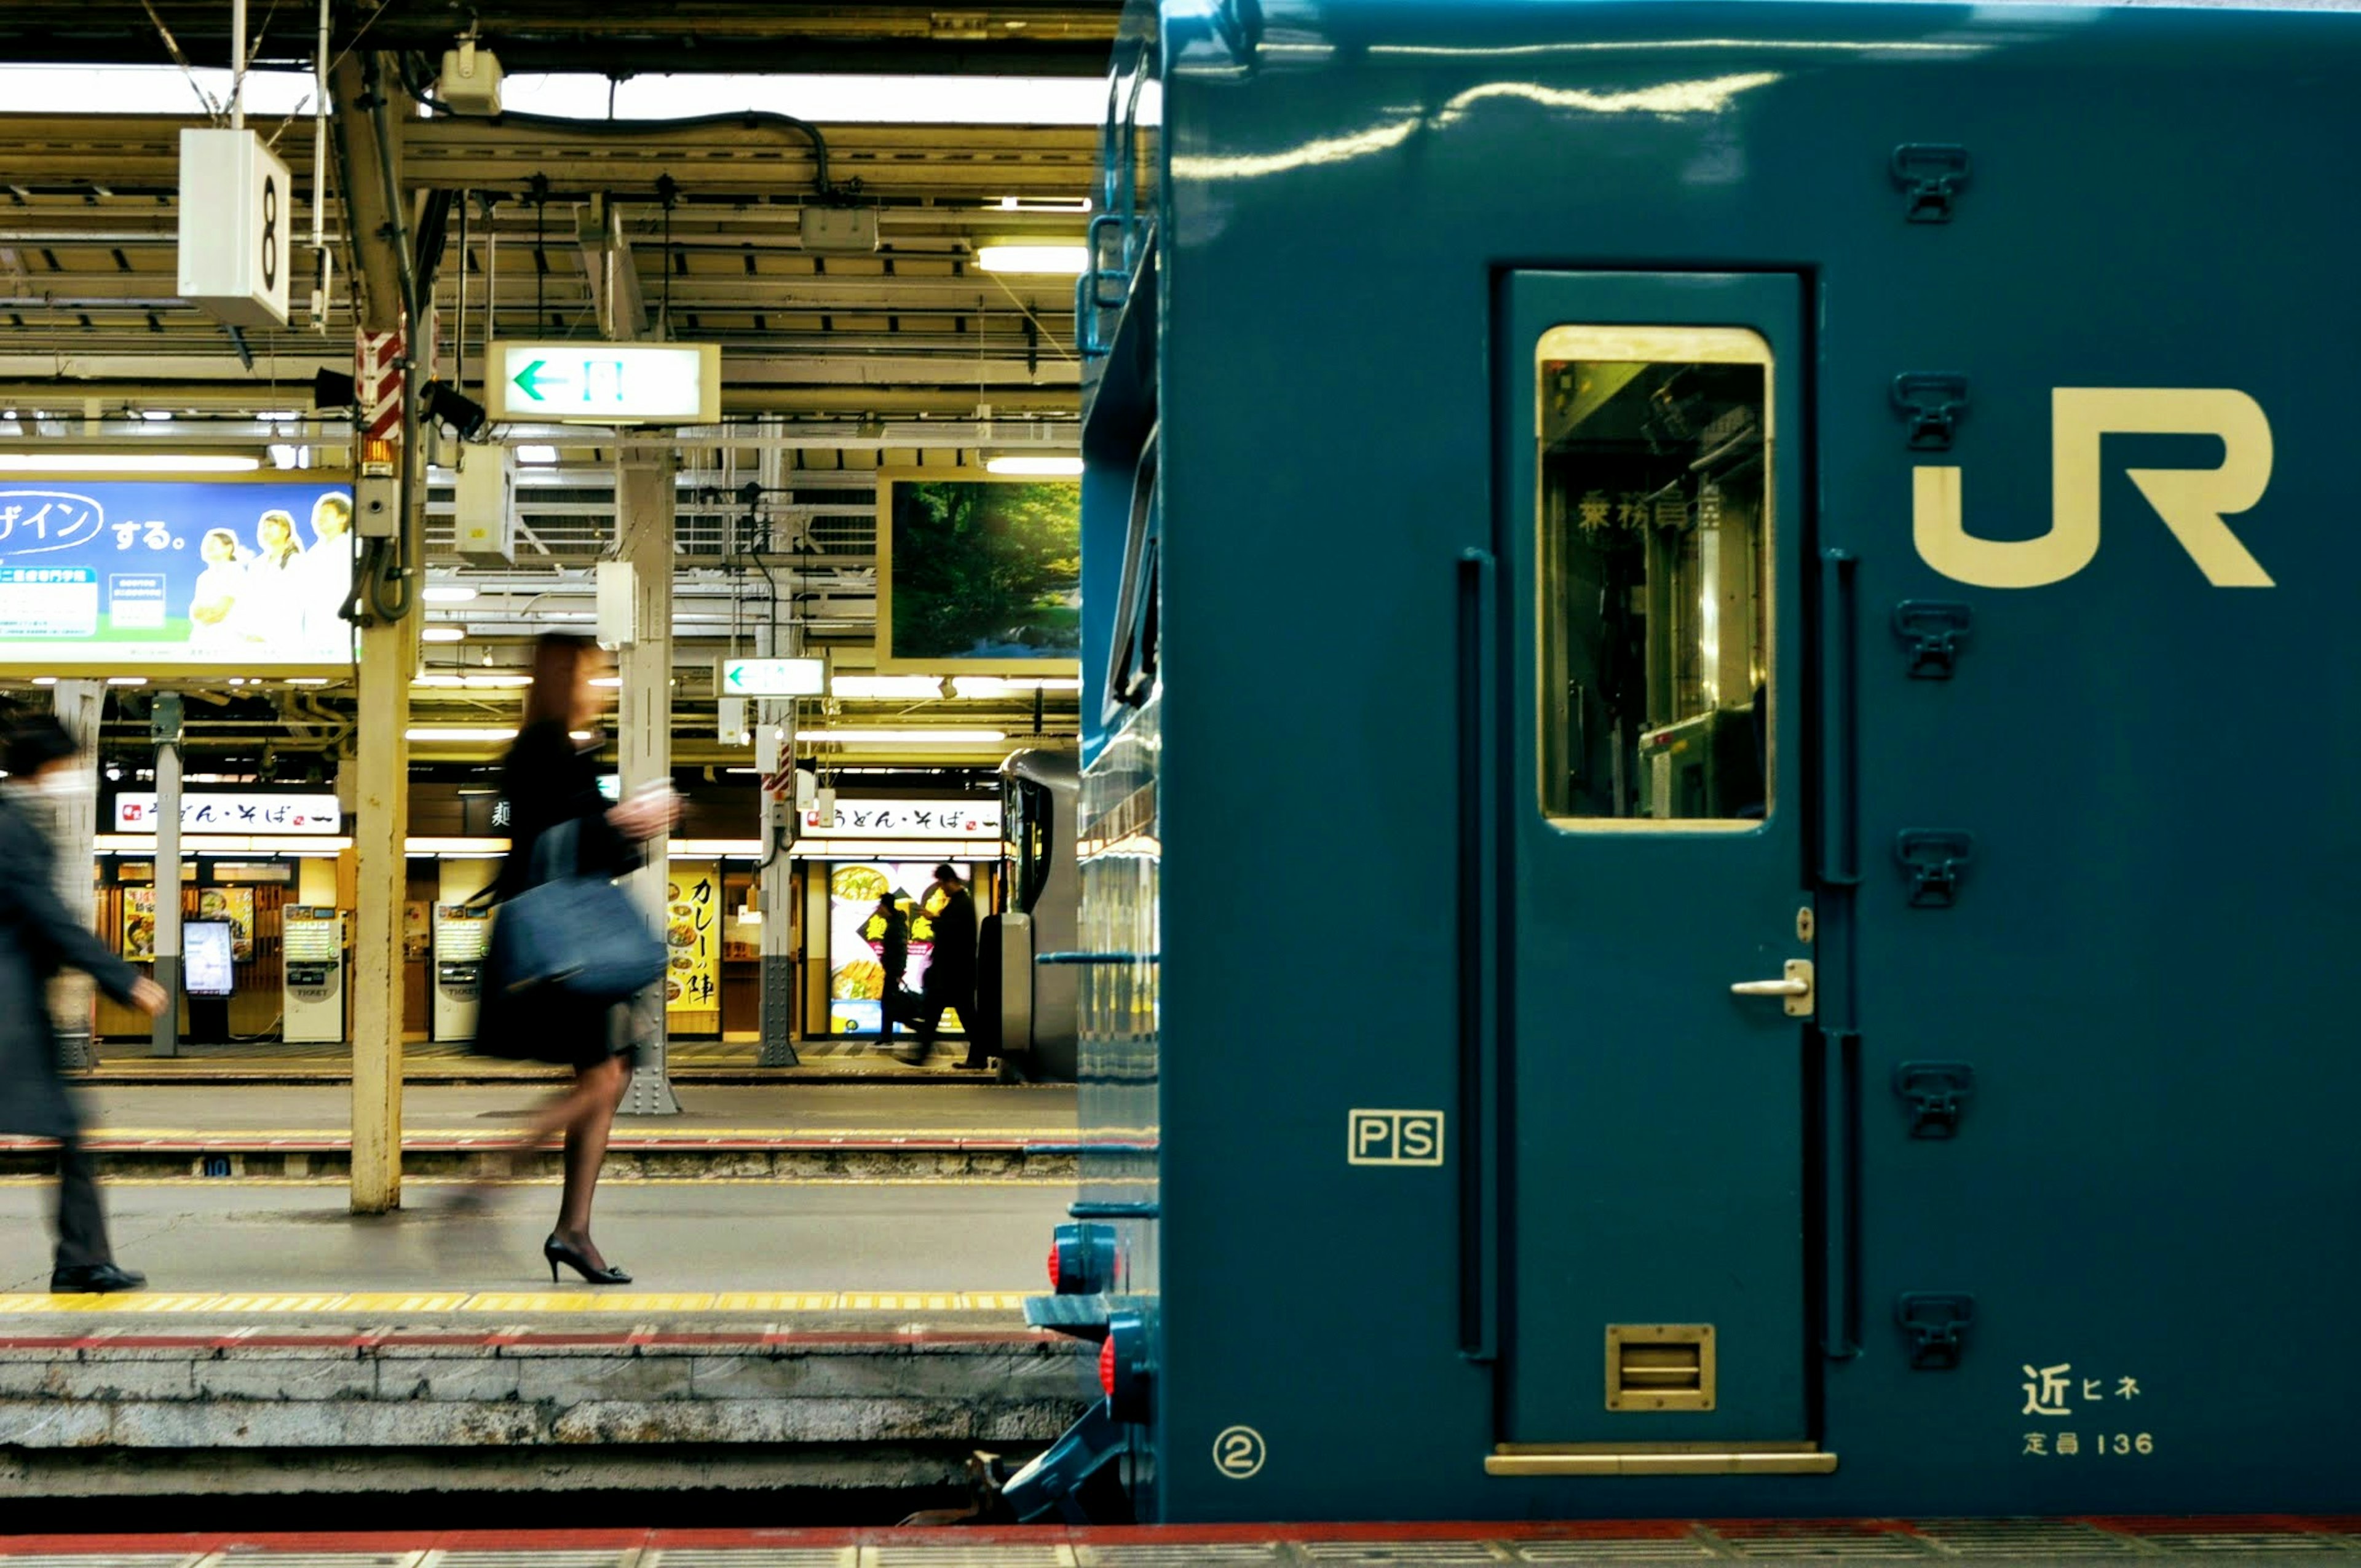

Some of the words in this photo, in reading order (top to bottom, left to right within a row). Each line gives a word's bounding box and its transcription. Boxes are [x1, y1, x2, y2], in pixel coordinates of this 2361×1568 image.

[263, 174, 276, 292] 8
[1913, 387, 2276, 588] JR
[0, 569, 86, 582] 二医療専門学院
[2022, 1432, 2079, 1455] 定員
[2097, 1433, 2154, 1455] 136
